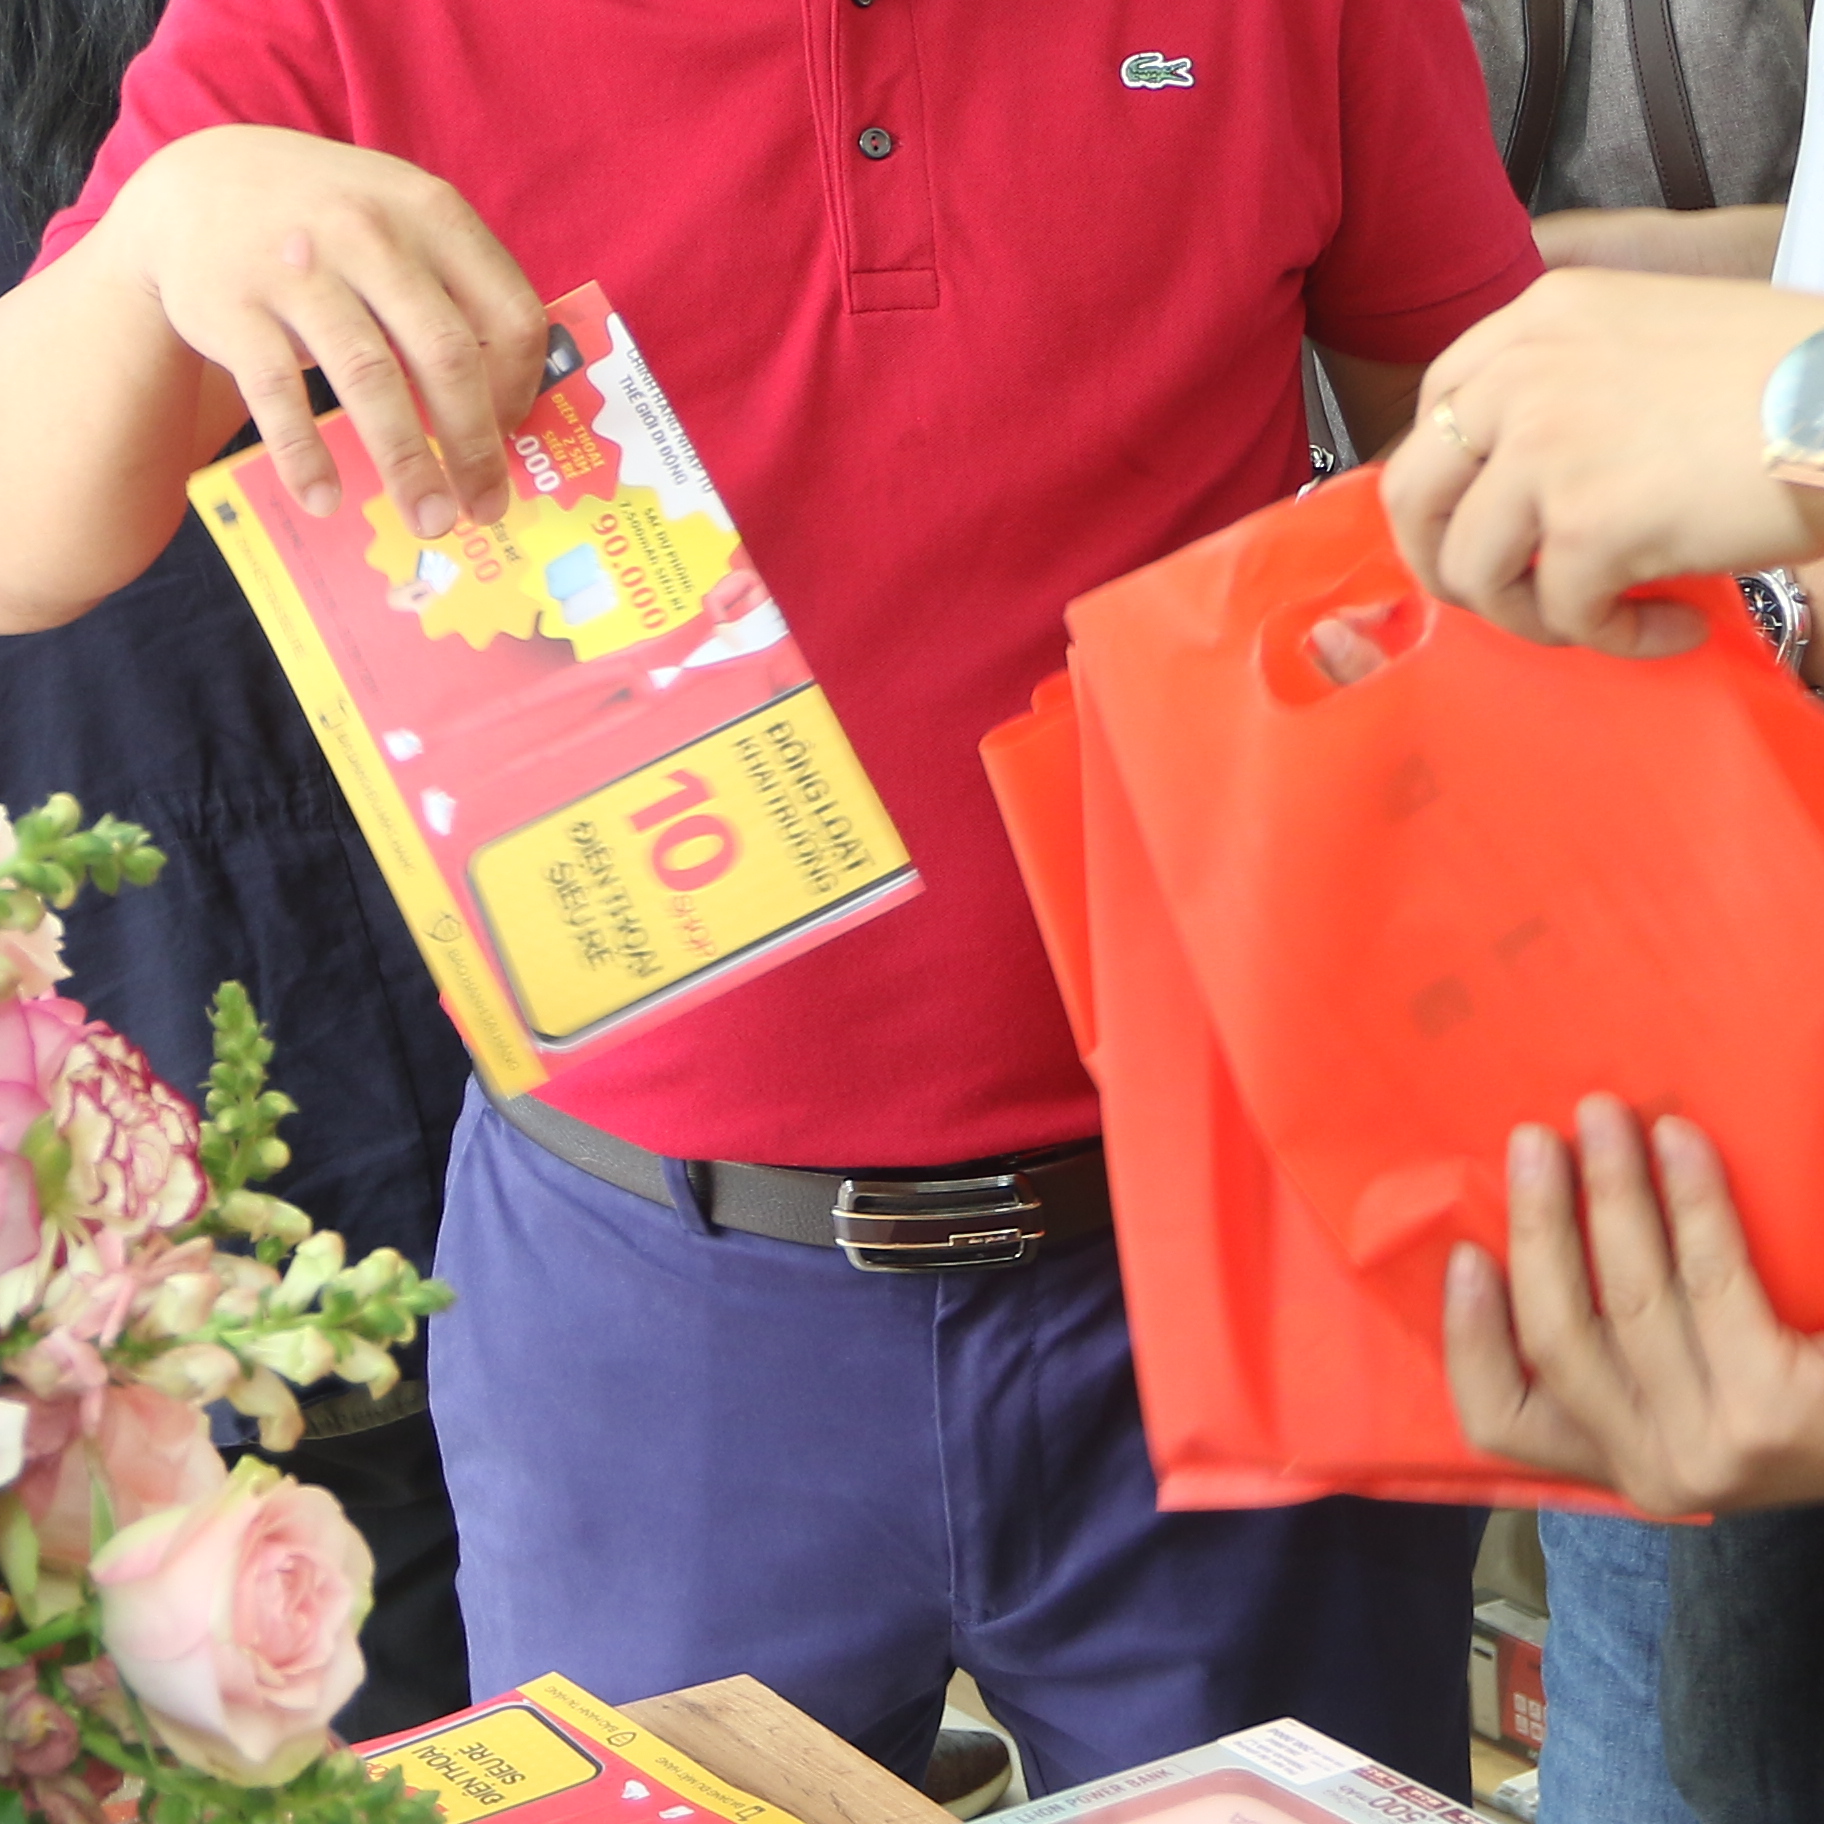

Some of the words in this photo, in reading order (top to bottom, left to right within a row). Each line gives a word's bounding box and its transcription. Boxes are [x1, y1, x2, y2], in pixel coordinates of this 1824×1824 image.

[619, 375, 643, 404] THẾ
[551, 393, 579, 428] ĐIỆN
[574, 424, 606, 469] THOẠI
[636, 401, 661, 435] GIỚI
[652, 430, 667, 447] DI
[542, 430, 568, 463] SIÊU
[571, 447, 592, 475] SIM
[659, 445, 688, 486] ĐỘNG
[590, 513, 668, 630] 90.000
[732, 735, 782, 794] KHAI
[763, 719, 831, 804] ĐỒNG
[810, 799, 876, 873] LOẠT
[629, 768, 738, 893] 10
[546, 860, 597, 928] SIÊU
[568, 819, 620, 887] ĐIỆN
[599, 885, 664, 980] THOẠI
[671, 894, 718, 958] SHOP
[410, 1743, 466, 1787] THOẠI
[460, 1770, 505, 1805] ĐIỆN
[486, 1751, 526, 1788] SIÊU
[1014, 1802, 1065, 1824] LI-ION
[1066, 1781, 1126, 1808] POWER
[1128, 1768, 1174, 1791] BANK
